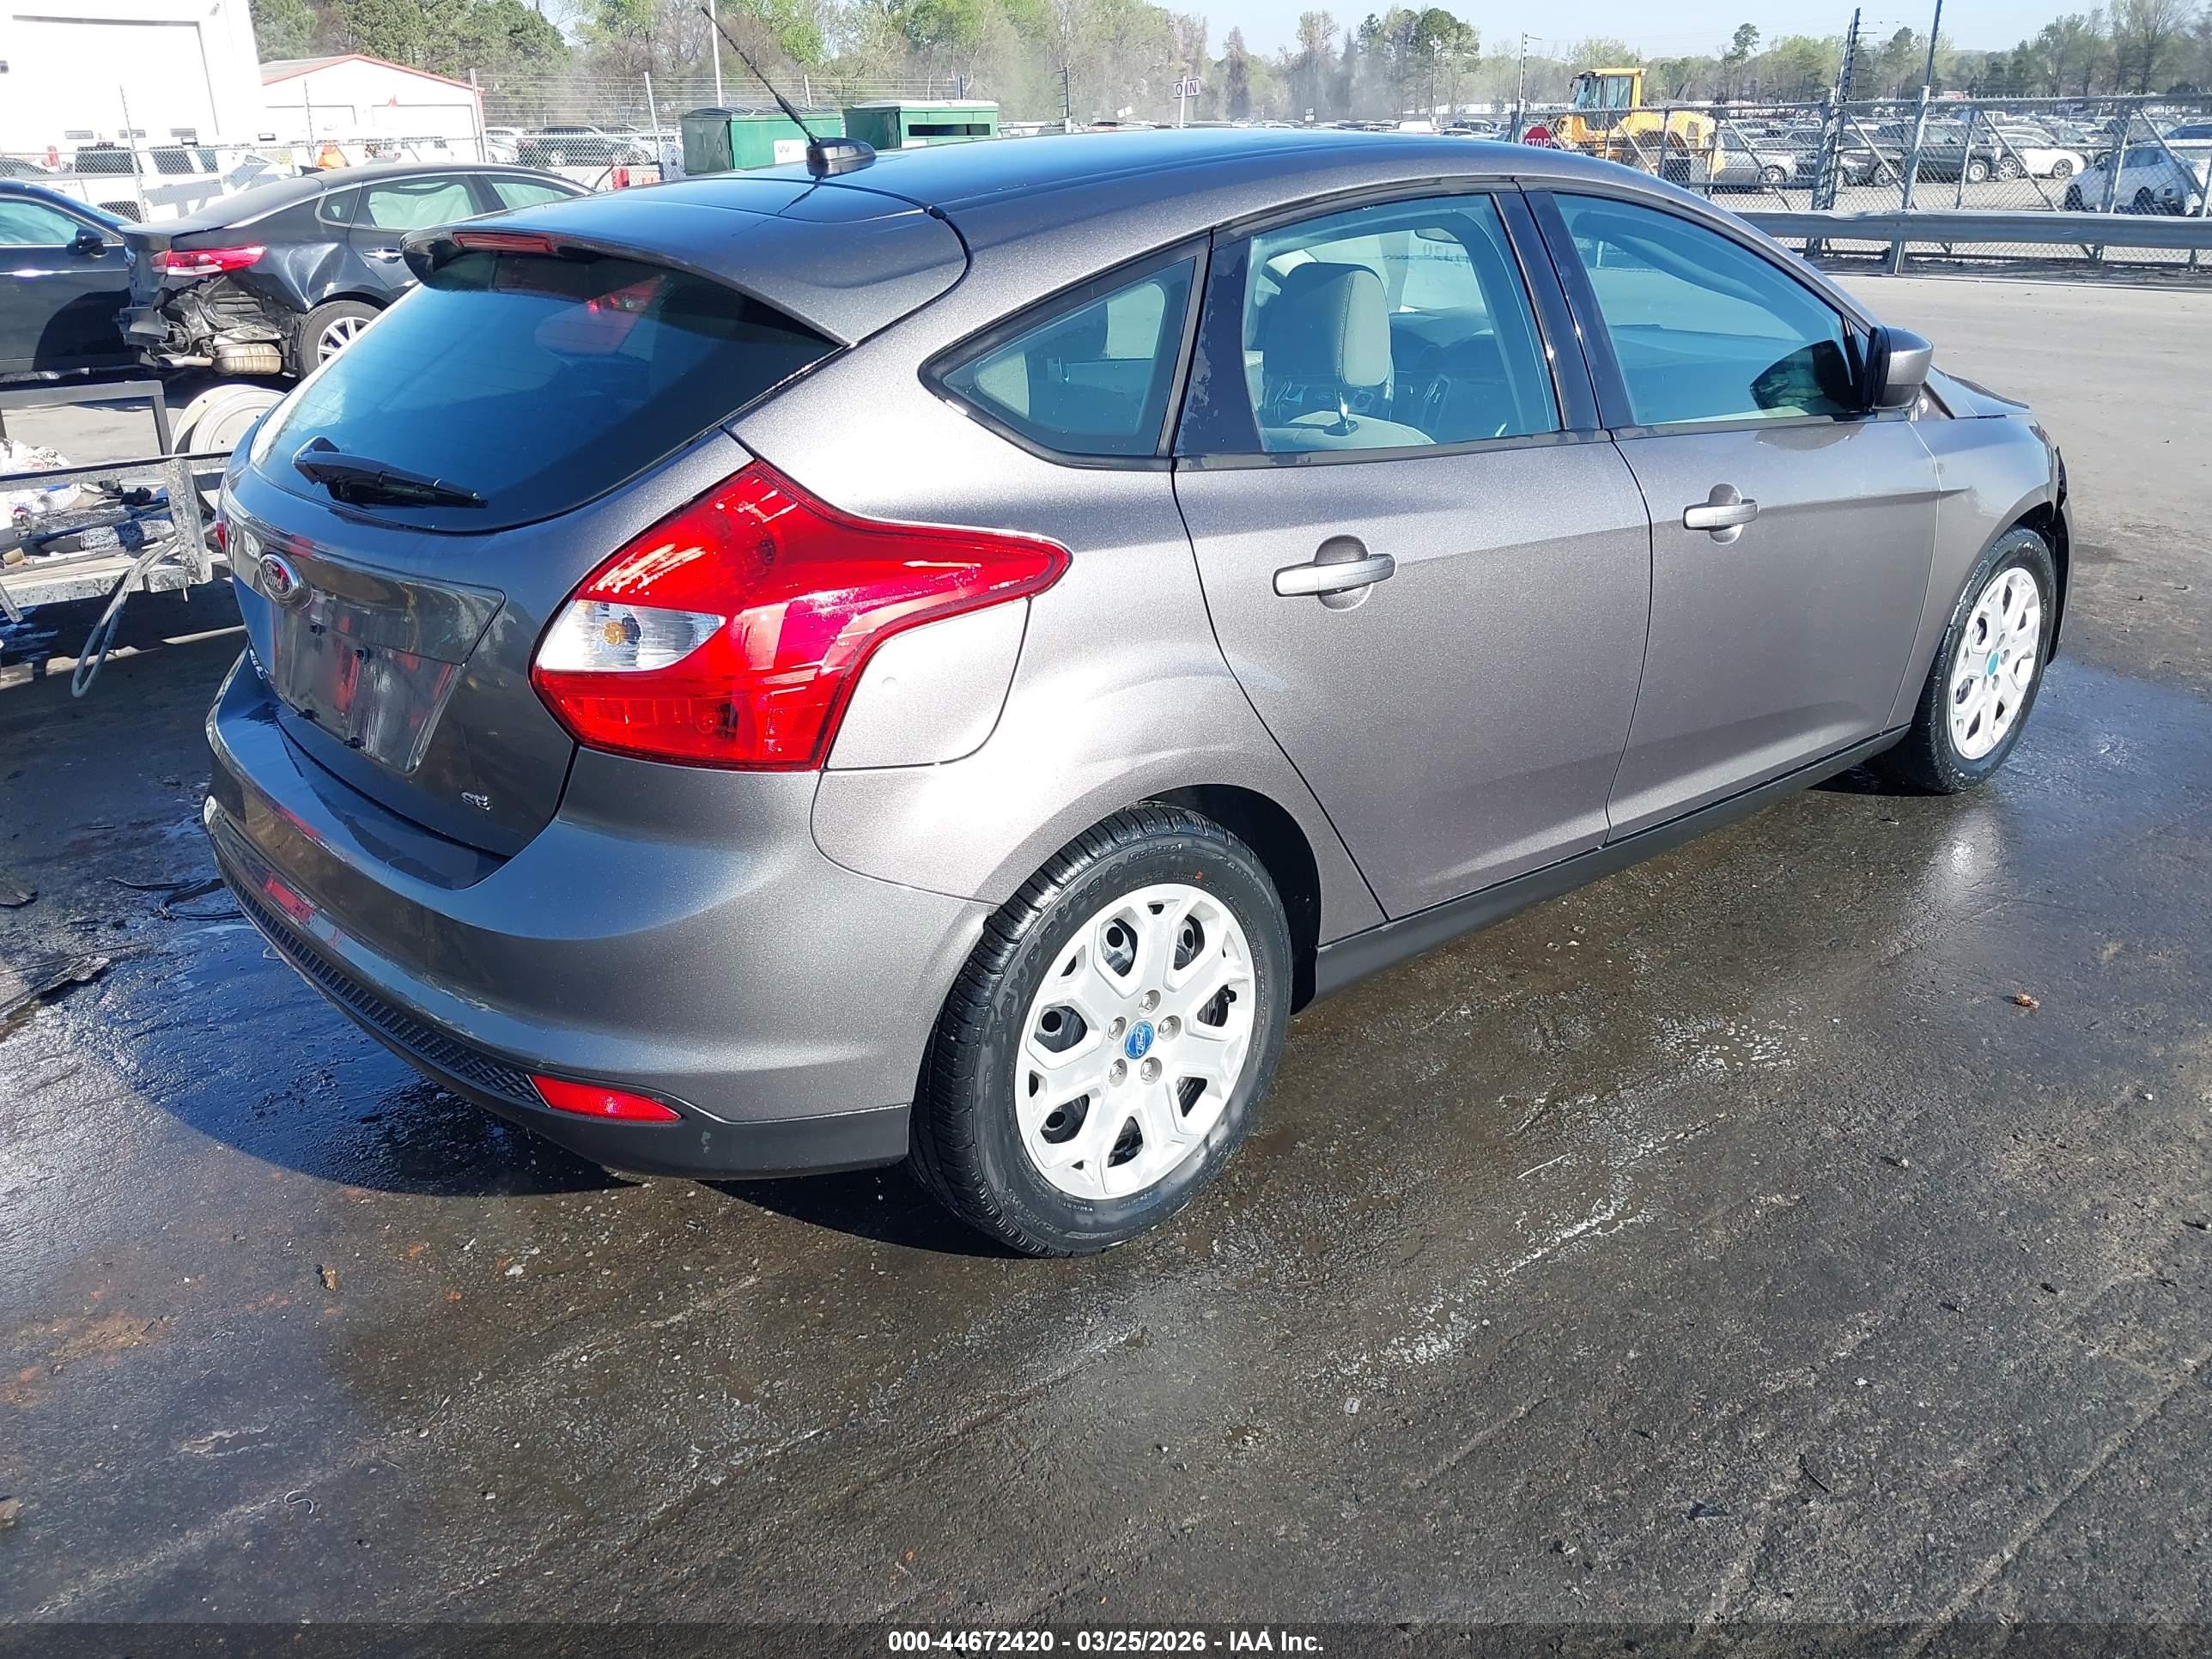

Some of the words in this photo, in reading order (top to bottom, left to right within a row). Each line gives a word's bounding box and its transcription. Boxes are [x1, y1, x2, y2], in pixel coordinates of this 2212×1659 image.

[1525, 138, 1550, 149] STOP
[264, 562, 283, 590] Ford
[461, 792, 490, 811] SE
